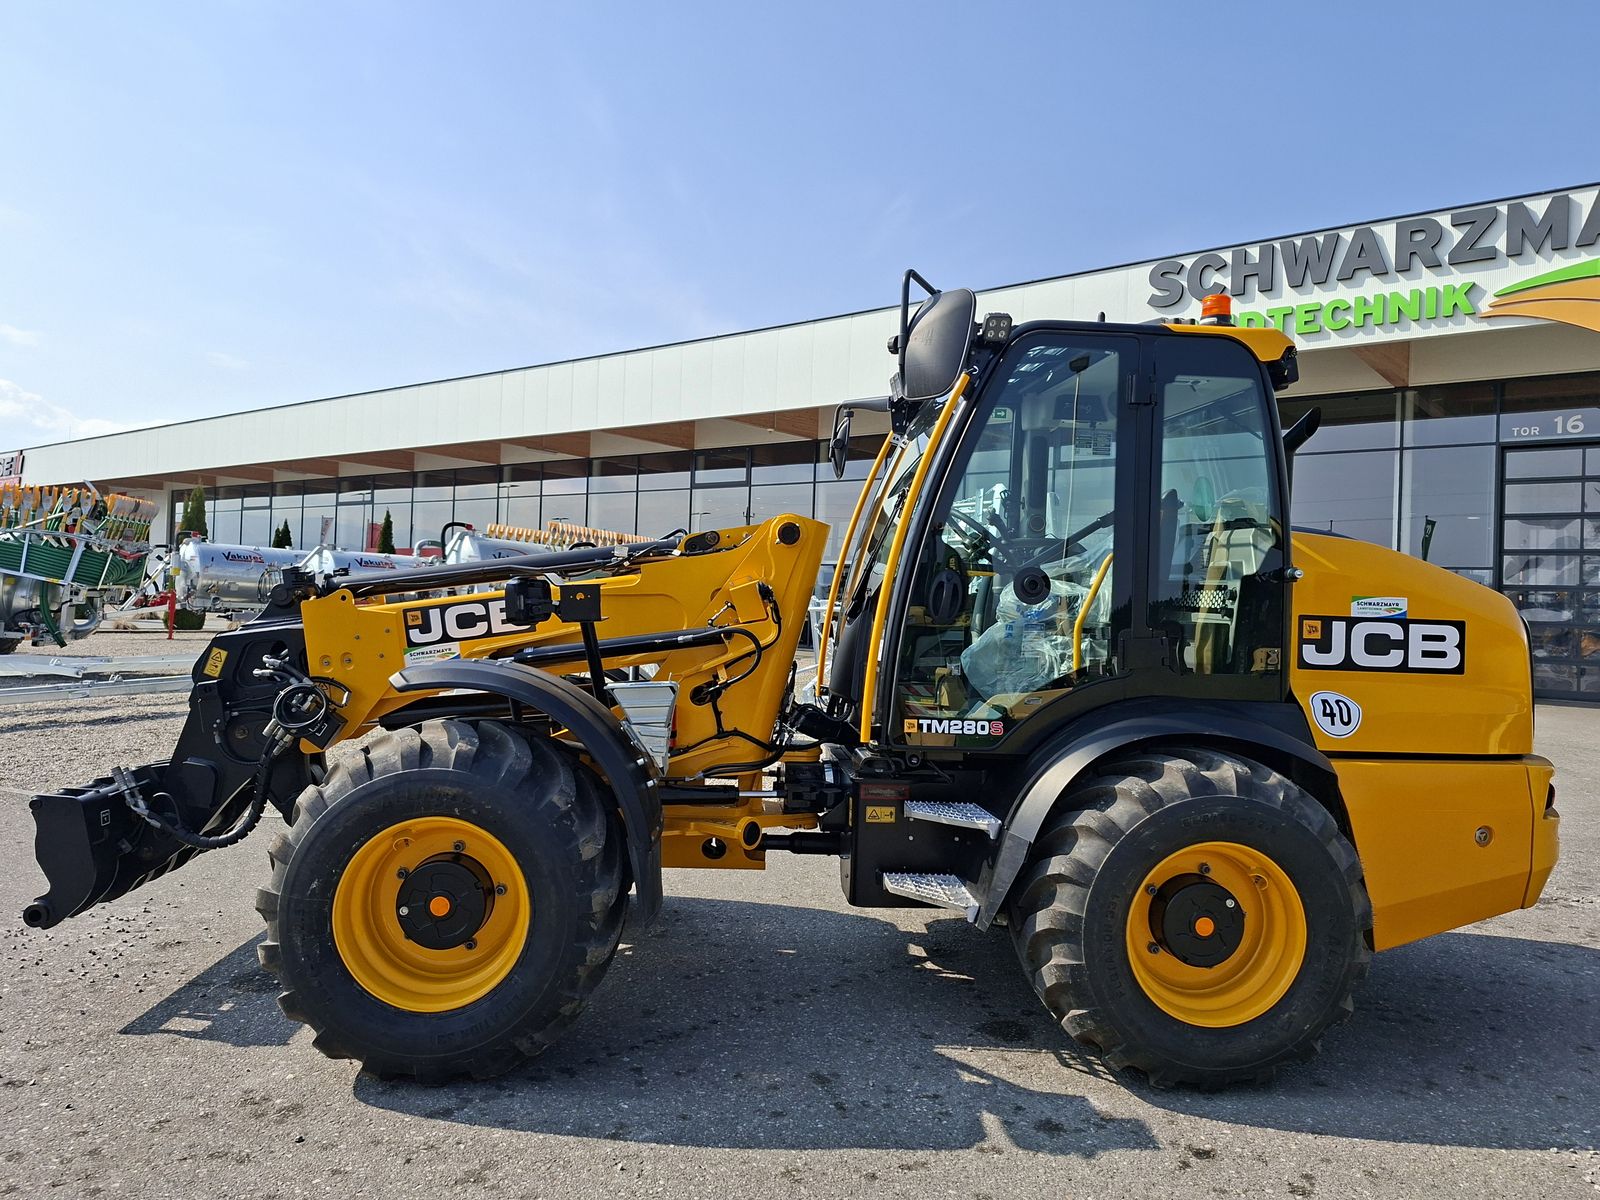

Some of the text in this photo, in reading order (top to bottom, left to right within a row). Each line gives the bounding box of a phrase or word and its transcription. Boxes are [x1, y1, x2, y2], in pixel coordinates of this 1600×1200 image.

[1512, 414, 1584, 437] TOR 16
[222, 551, 264, 561] Vakutec
[1302, 620, 1461, 669] JCB
[1321, 698, 1352, 727] 40
[918, 719, 1004, 736] TM280S
